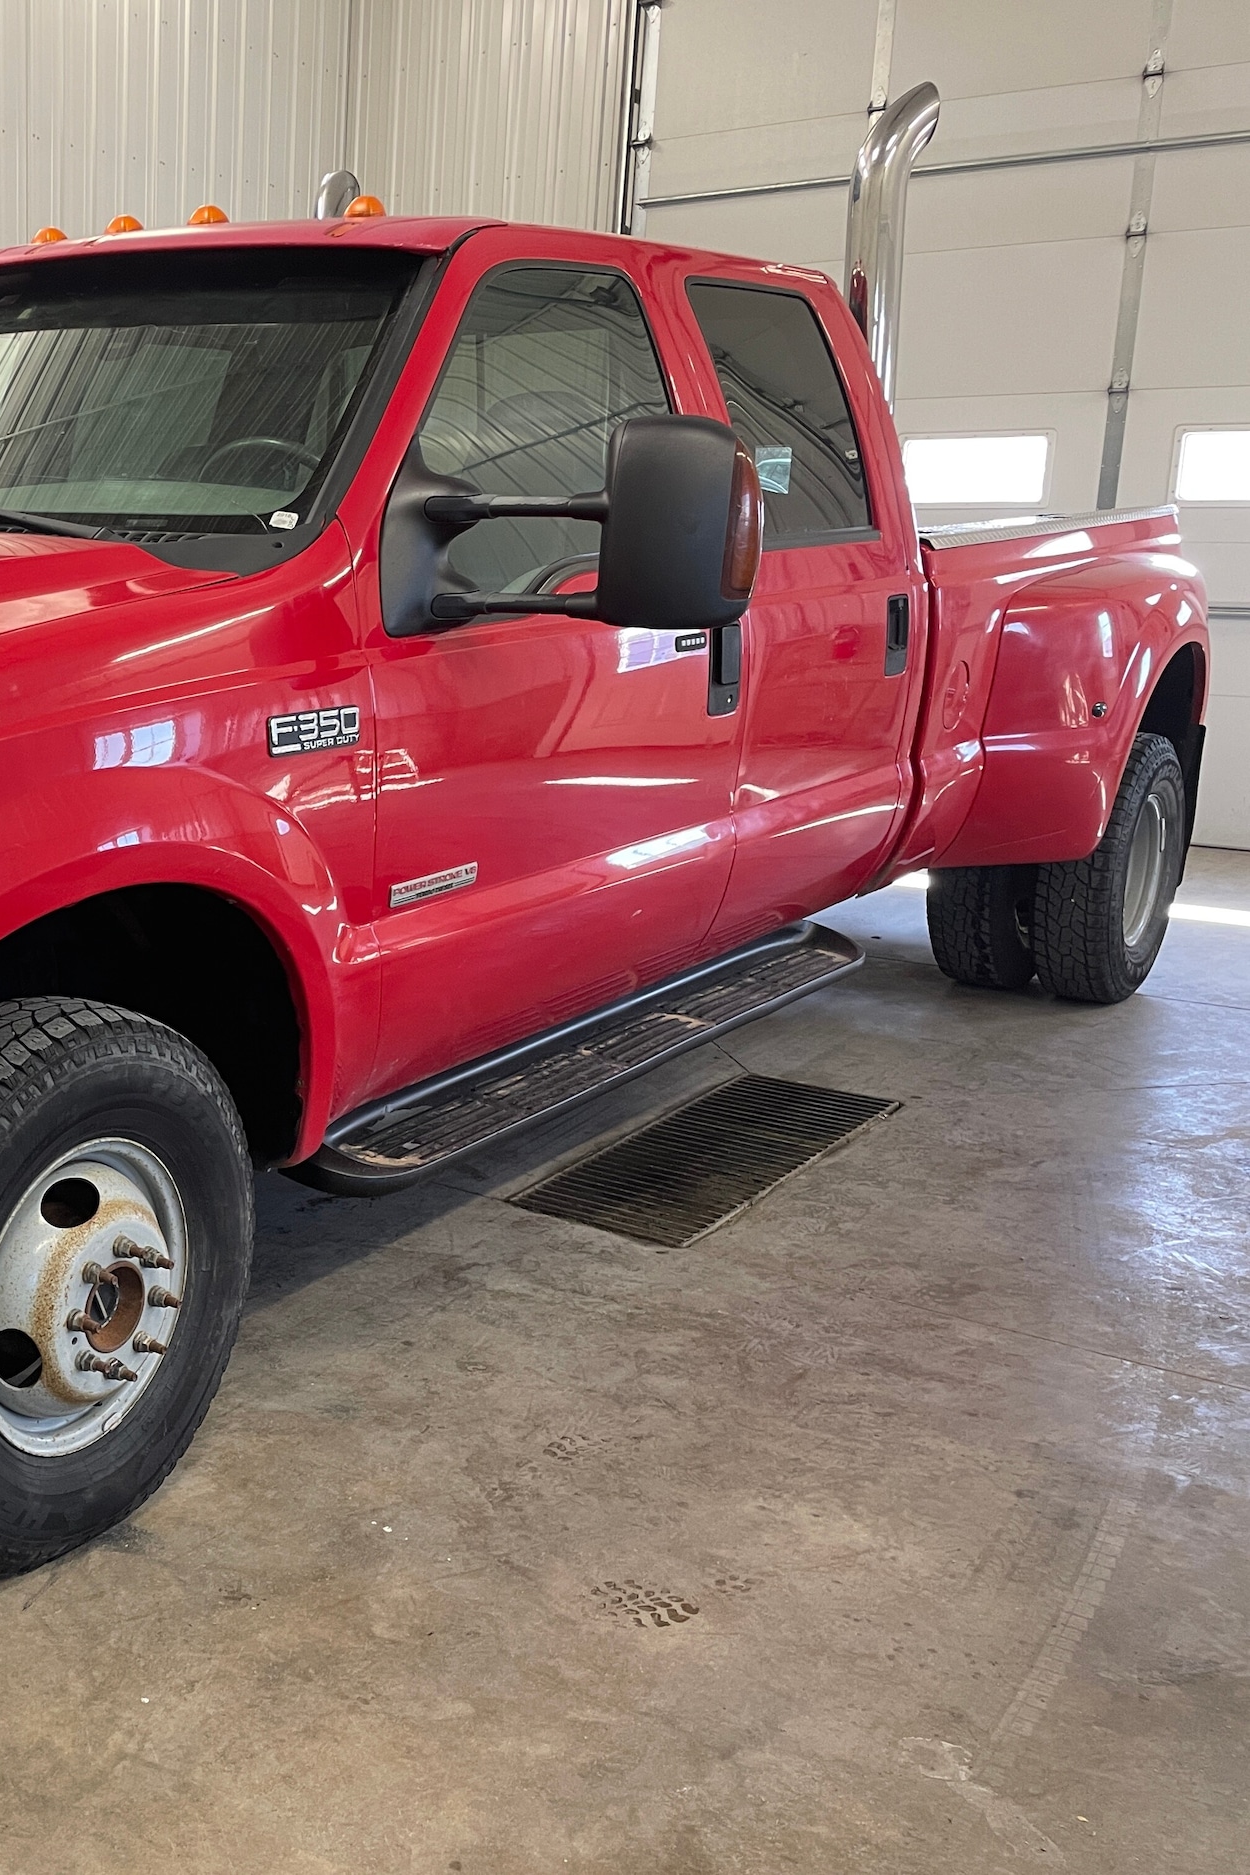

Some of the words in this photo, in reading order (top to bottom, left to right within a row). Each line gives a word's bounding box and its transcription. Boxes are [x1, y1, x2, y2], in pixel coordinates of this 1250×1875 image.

[303, 739, 334, 750] SUPER
[336, 733, 359, 744] DUTY
[393, 880, 427, 896] POWER
[427, 869, 463, 887] STROKE
